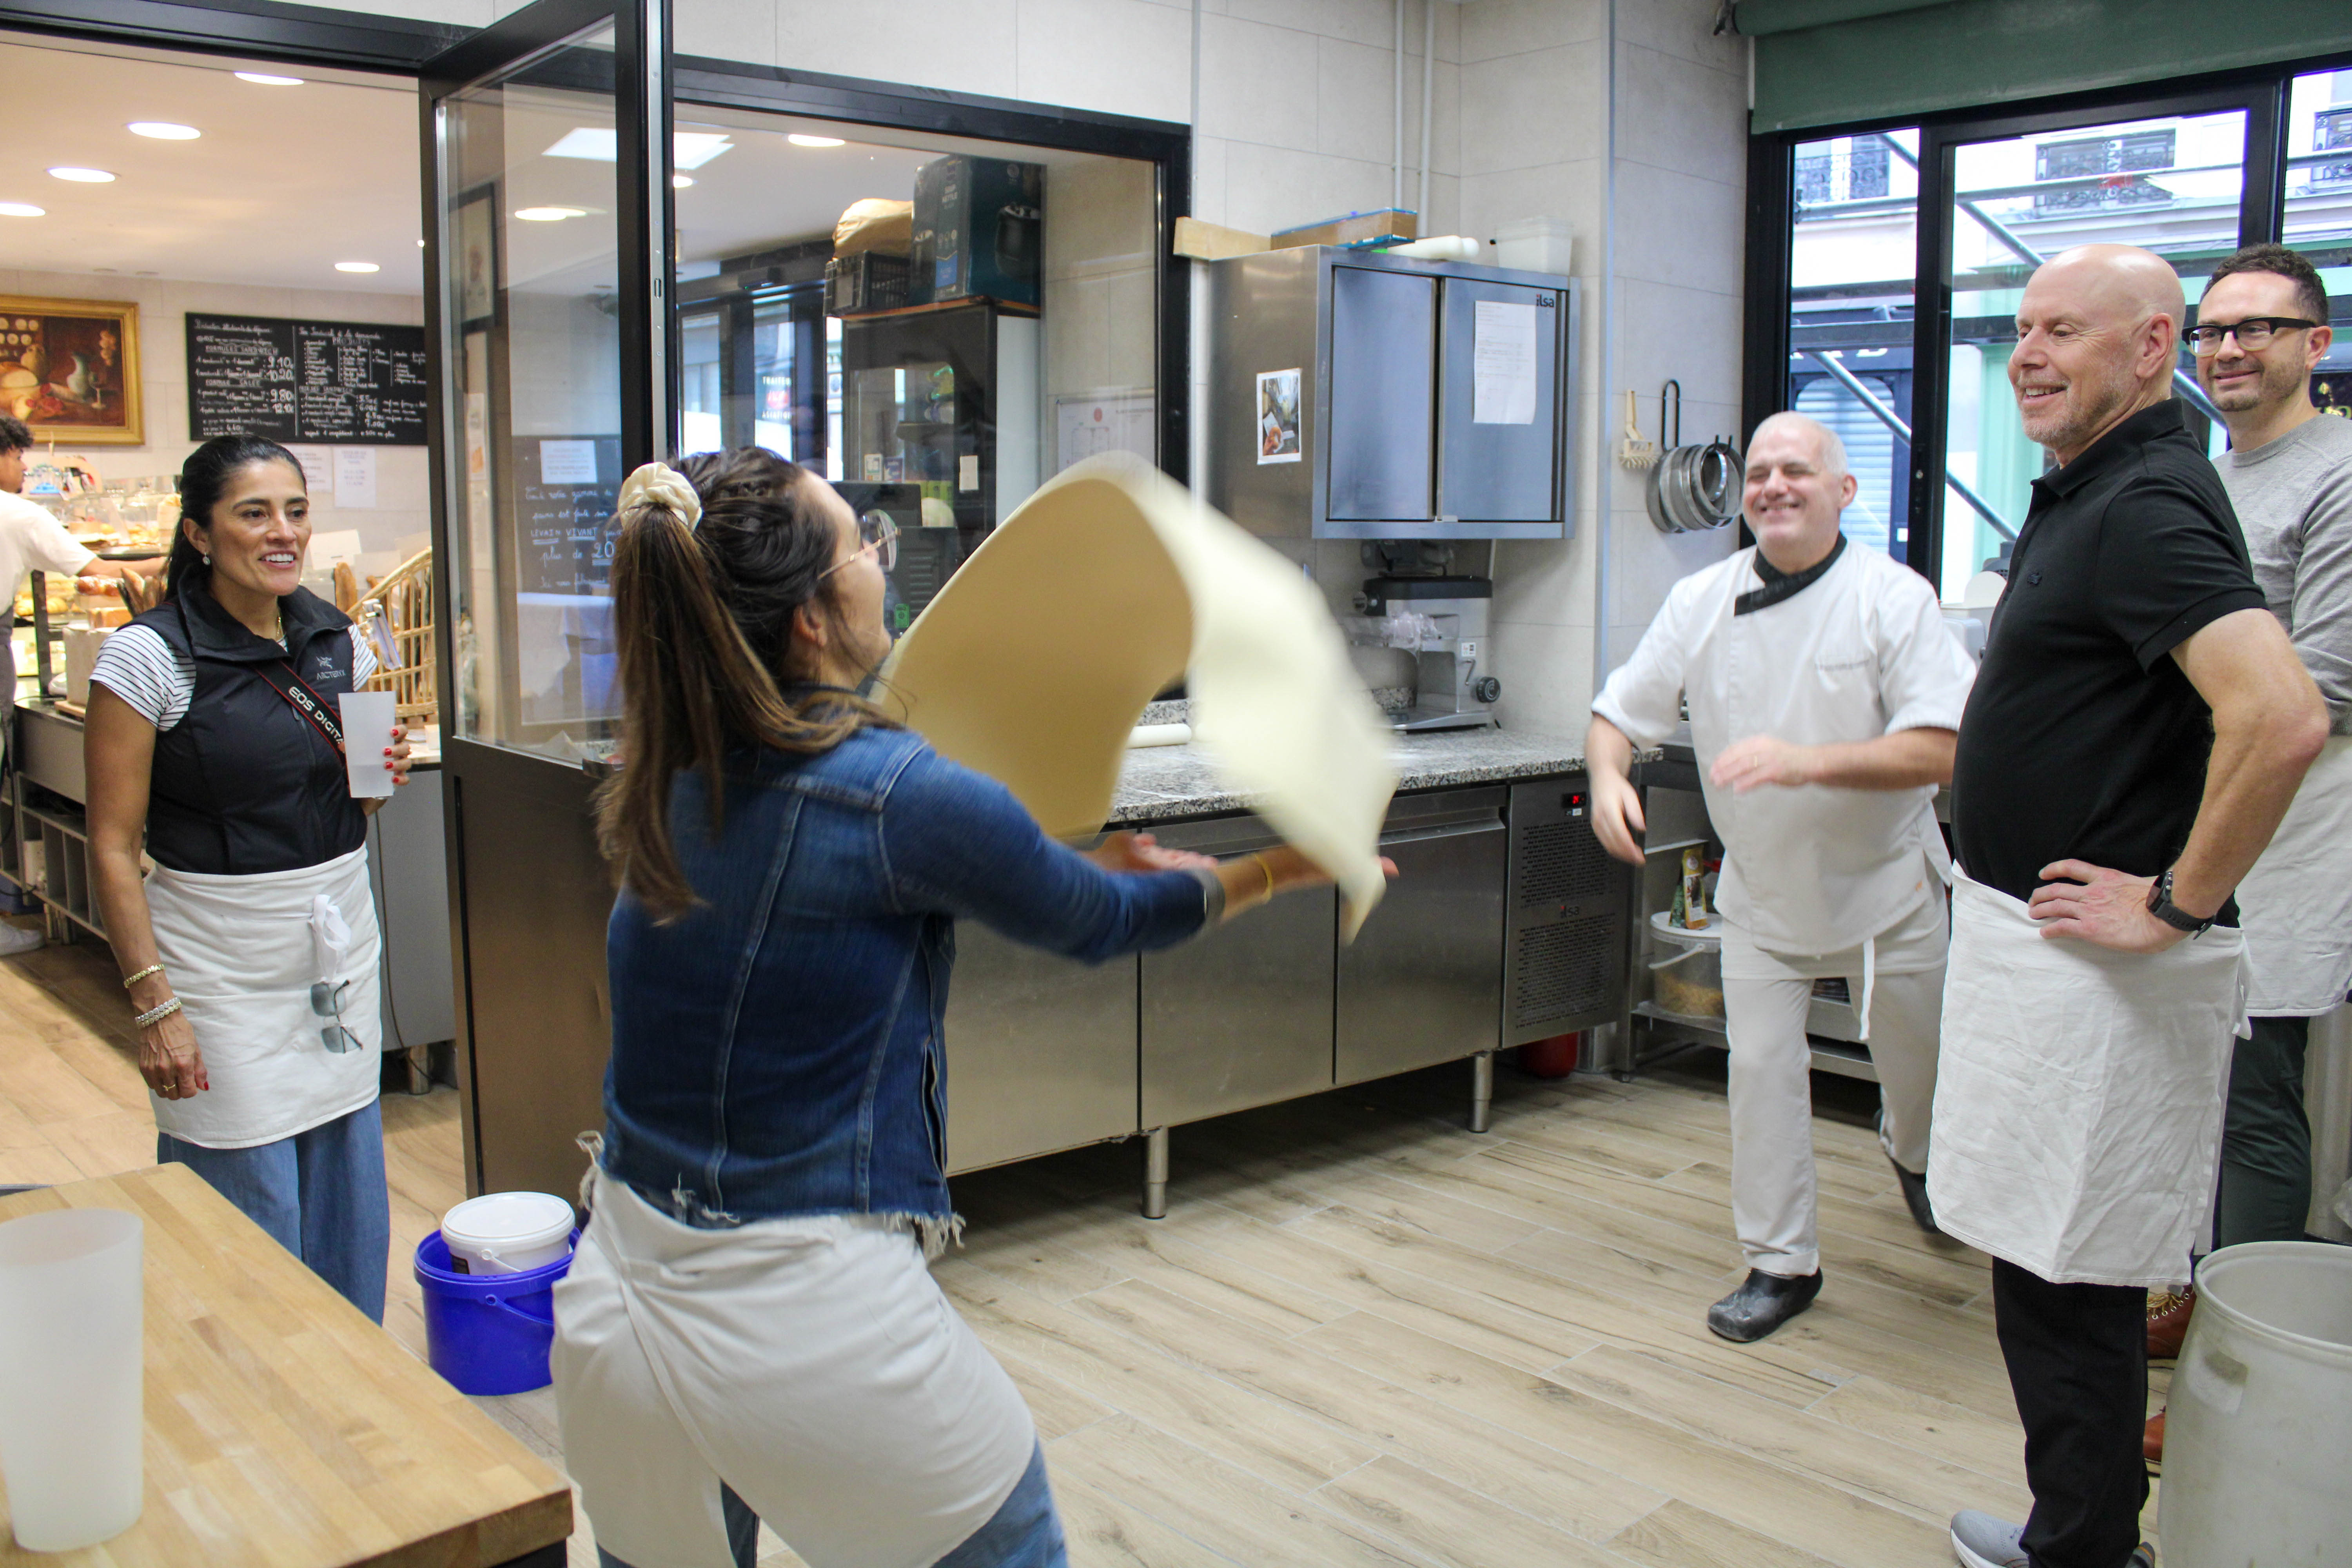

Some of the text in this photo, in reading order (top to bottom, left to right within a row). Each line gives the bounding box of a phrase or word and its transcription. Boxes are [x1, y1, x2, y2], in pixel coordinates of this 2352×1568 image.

[1536, 294, 1555, 308] ilsa
[591, 541, 615, 559] 20
[289, 686, 316, 711] EOS
[1560, 905, 1580, 919] ilsa
